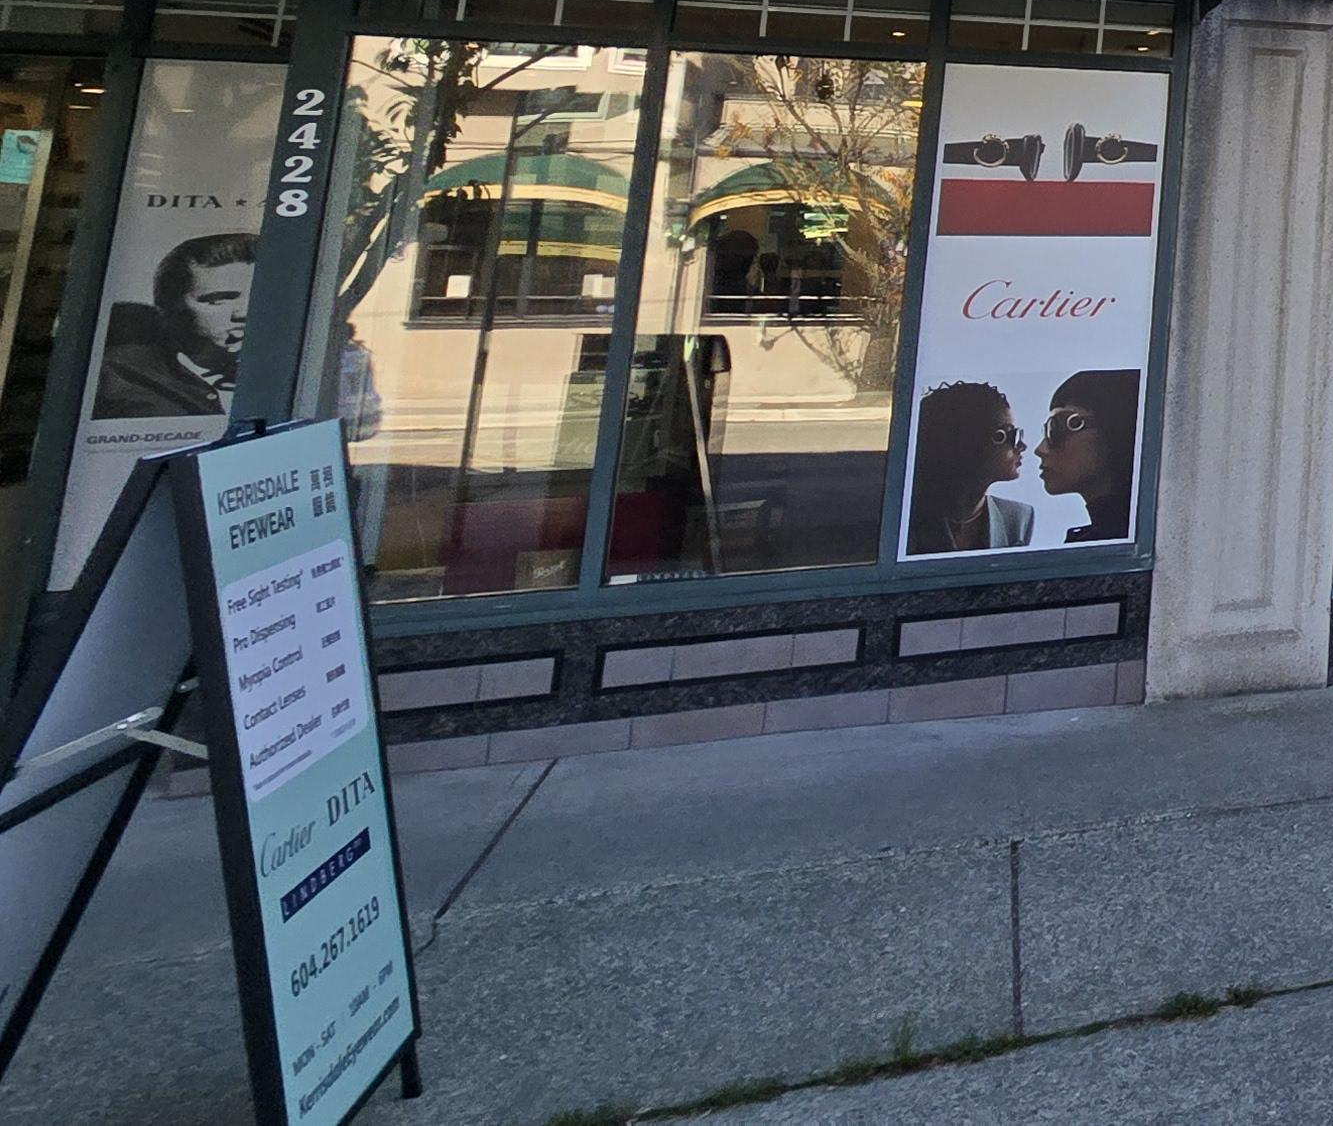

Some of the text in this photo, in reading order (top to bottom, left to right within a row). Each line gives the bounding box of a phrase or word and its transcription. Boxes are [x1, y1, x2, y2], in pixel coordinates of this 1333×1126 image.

[275, 88, 327, 218] 2428
[146, 194, 224, 209] DITA
[961, 279, 1117, 321] Cartier
[216, 469, 300, 516] KERRISDALE
[228, 506, 296, 550] EYEWEAR
[227, 597, 248, 616] Free
[248, 584, 270, 608] Sight
[233, 636, 250, 654] Pro
[250, 614, 297, 646] Dispensing
[239, 665, 272, 693] Myopia
[272, 643, 303, 673] Control
[243, 701, 278, 731] Contact
[278, 685, 306, 711] Lenses
[249, 726, 296, 770] Authorized
[296, 714, 322, 741] Dealer
[260, 771, 376, 878] Cartier DITA
[290, 895, 381, 998] 604.267.1619
